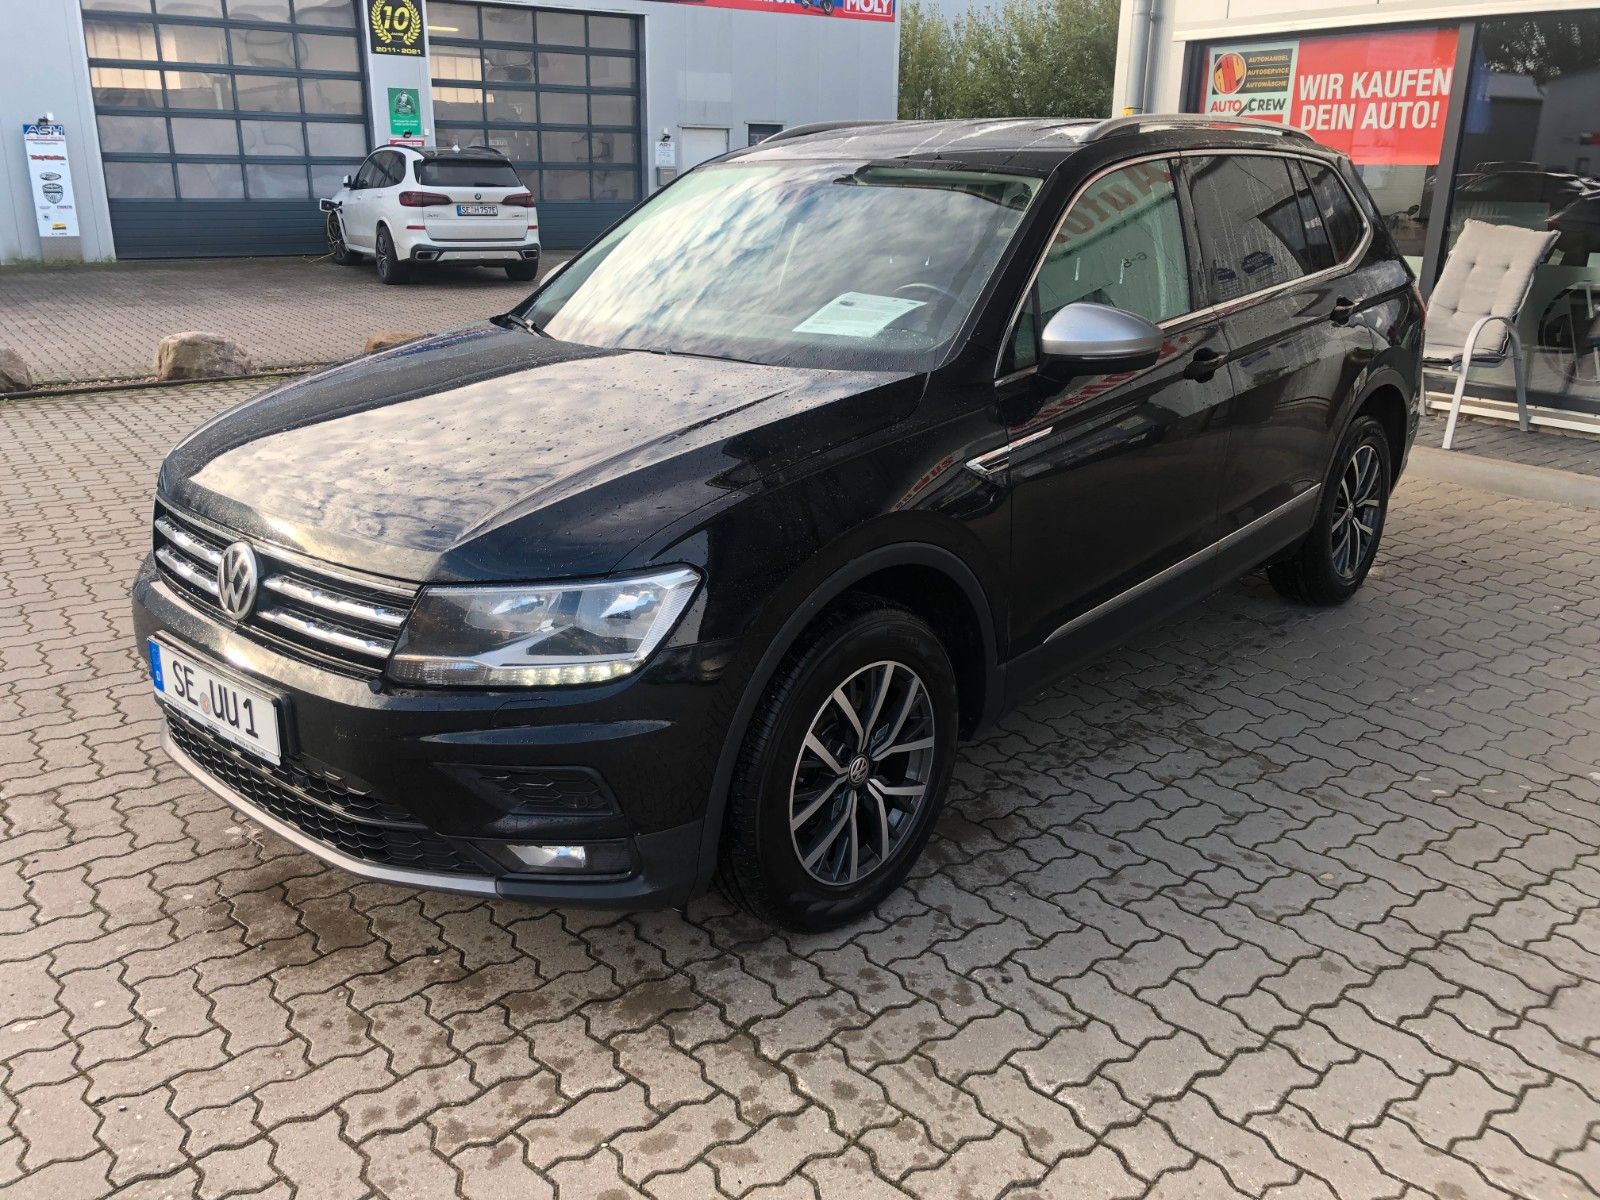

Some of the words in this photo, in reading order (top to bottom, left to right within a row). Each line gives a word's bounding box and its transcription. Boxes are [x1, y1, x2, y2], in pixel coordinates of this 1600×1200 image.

[846, 0, 890, 14] MOLY
[383, 6, 410, 31] 10
[1248, 54, 1289, 63] AUTOHANDEL
[1247, 67, 1289, 76] AUTOSERVICE
[1300, 73, 1344, 101] WIR
[1351, 67, 1453, 99] KAUFEN
[1248, 98, 1287, 112] CREW
[1301, 103, 1356, 131] DEIN
[1361, 101, 1440, 130] AUTO!
[26, 125, 64, 136] ASH
[172, 660, 199, 707] SE
